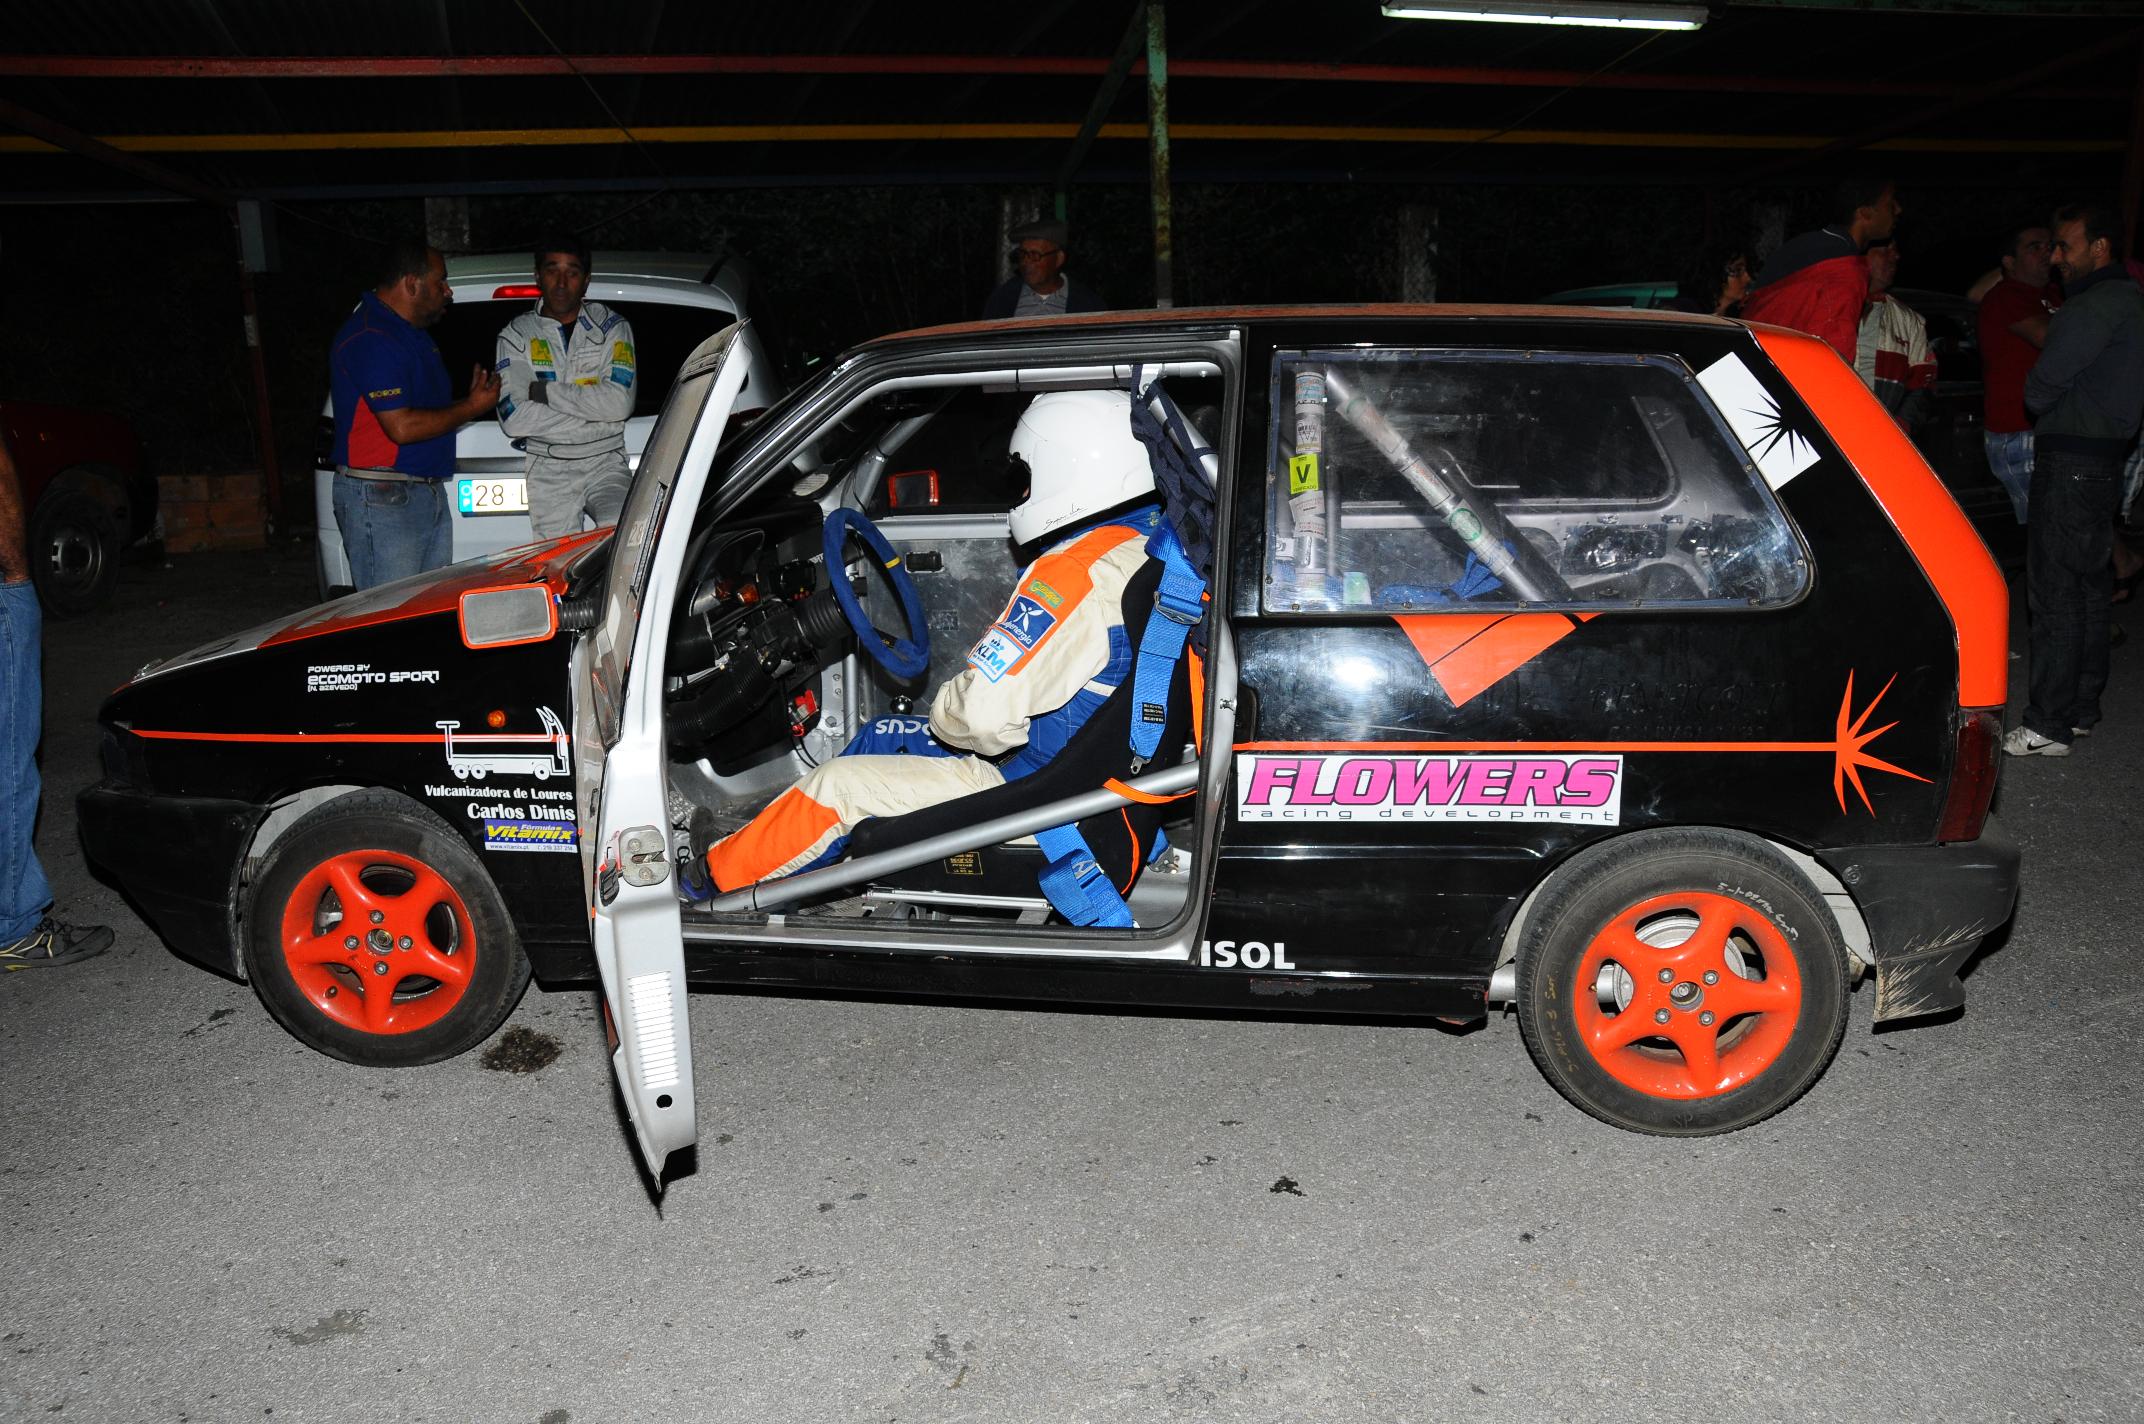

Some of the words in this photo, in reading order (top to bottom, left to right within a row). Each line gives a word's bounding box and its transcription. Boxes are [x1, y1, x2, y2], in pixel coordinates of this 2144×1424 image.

[1296, 464, 1311, 483] V
[476, 484, 504, 506] 28
[977, 642, 1008, 672] KLM
[307, 664, 355, 674] POWERED
[356, 663, 371, 672] BY
[389, 670, 440, 684] SPORT
[1243, 757, 1621, 806] FLOWERS
[424, 785, 511, 799] Vulcanizadora
[513, 787, 529, 799] de
[530, 787, 574, 801] Loures
[466, 802, 526, 819] Carlos
[528, 804, 576, 821] Dinis
[1240, 808, 1352, 820] racing
[1379, 807, 1615, 822] development
[486, 824, 575, 840] Vitamix
